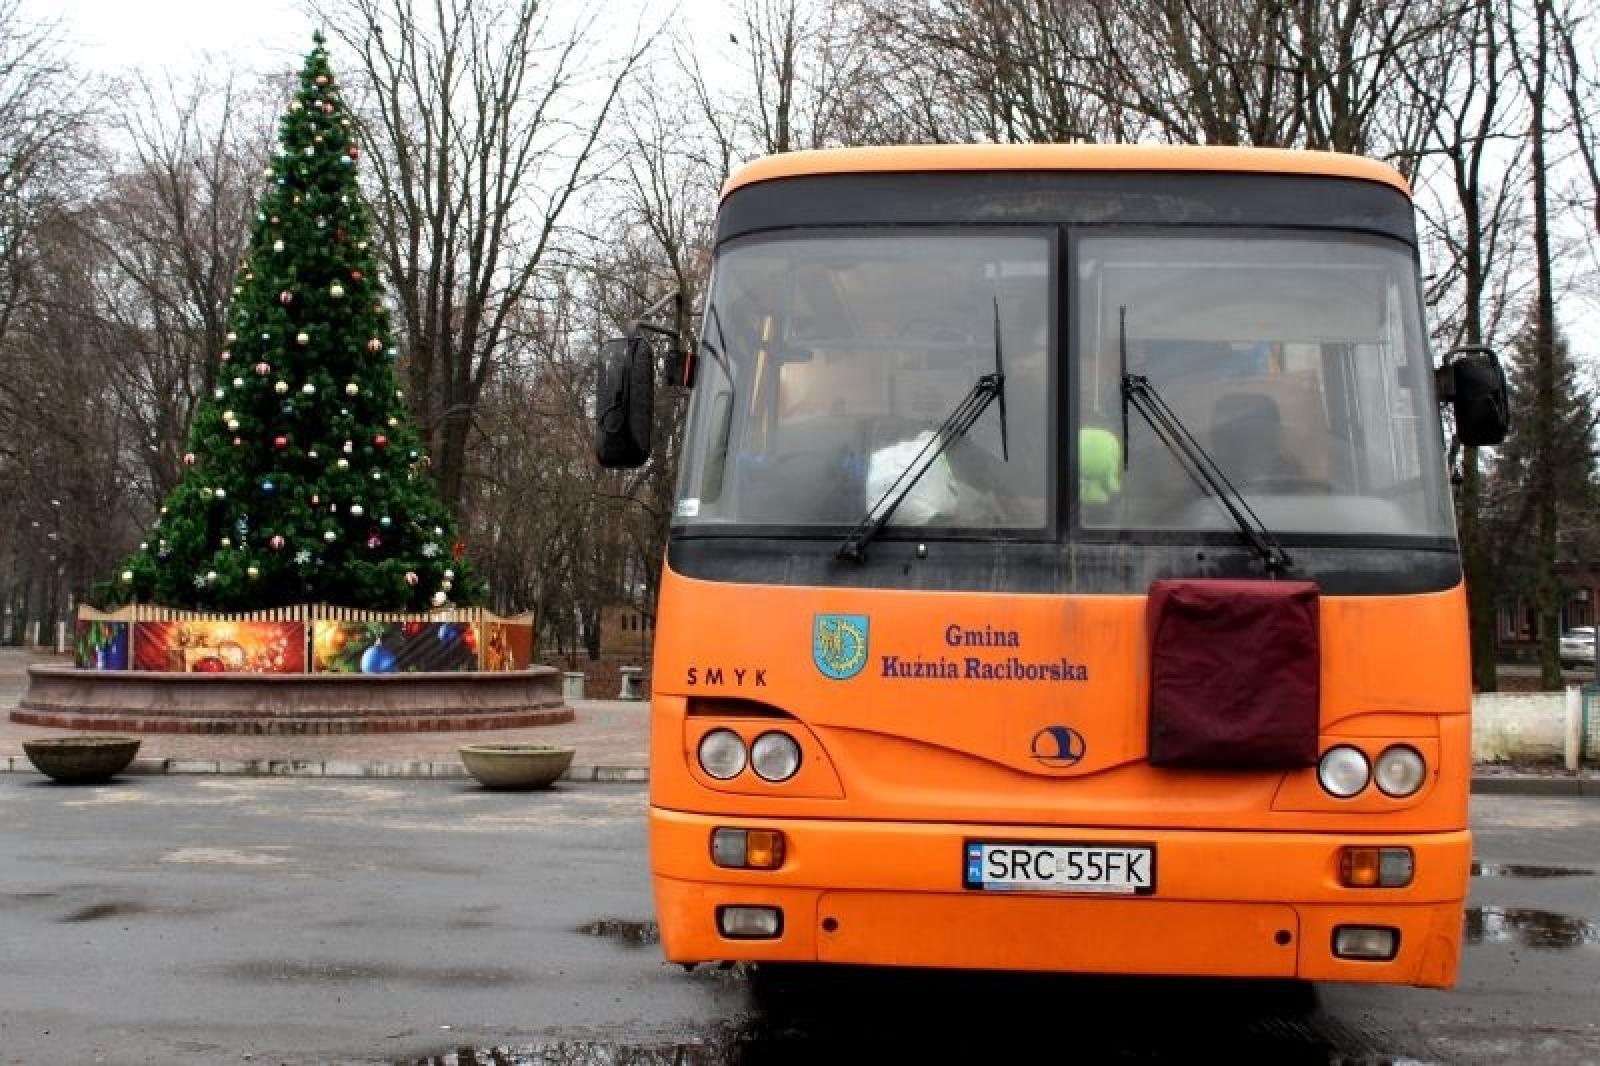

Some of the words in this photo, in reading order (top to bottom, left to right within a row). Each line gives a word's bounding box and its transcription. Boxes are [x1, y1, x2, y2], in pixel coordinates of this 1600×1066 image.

[945, 624, 1020, 647] Gmina
[687, 666, 767, 686] SMYK
[964, 657, 1089, 681] Raciborska
[988, 849, 1055, 880] SRC
[1067, 851, 1144, 883] 55FK
